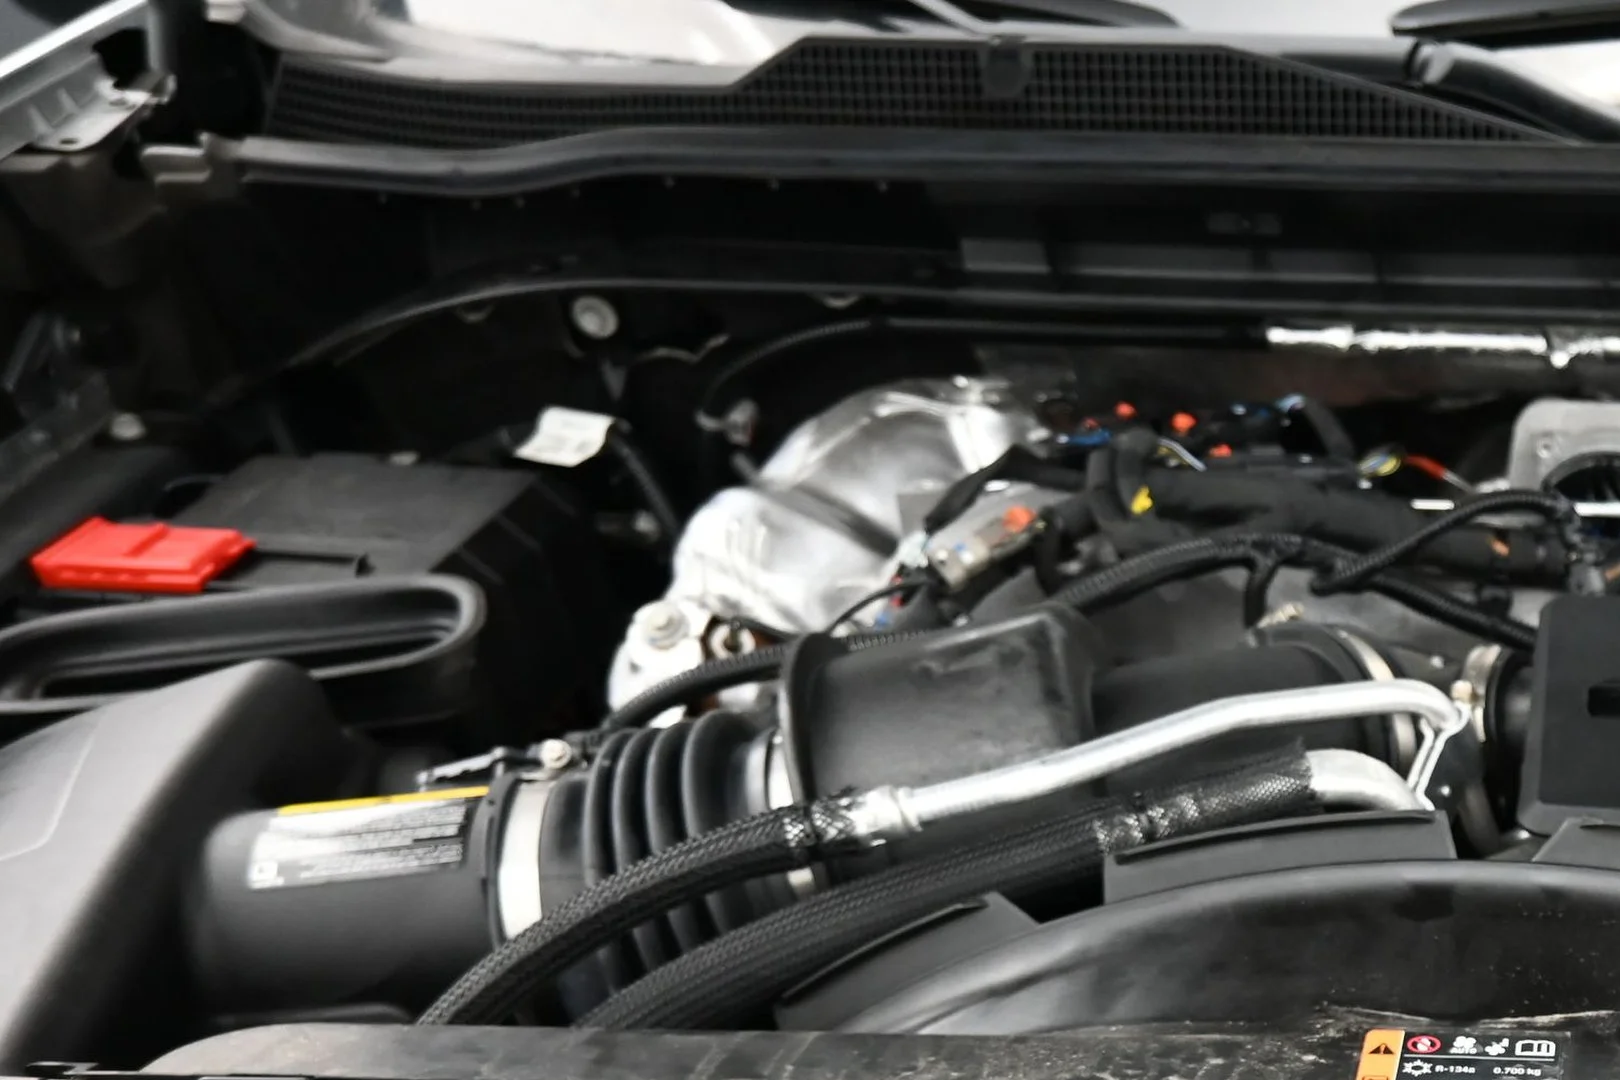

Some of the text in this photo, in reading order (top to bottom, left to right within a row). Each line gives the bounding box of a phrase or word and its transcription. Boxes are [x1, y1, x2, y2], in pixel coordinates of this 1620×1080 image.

[1450, 1046, 1477, 1054] AUTO
[1434, 1065, 1542, 1078] R-134a 0.700 kg
